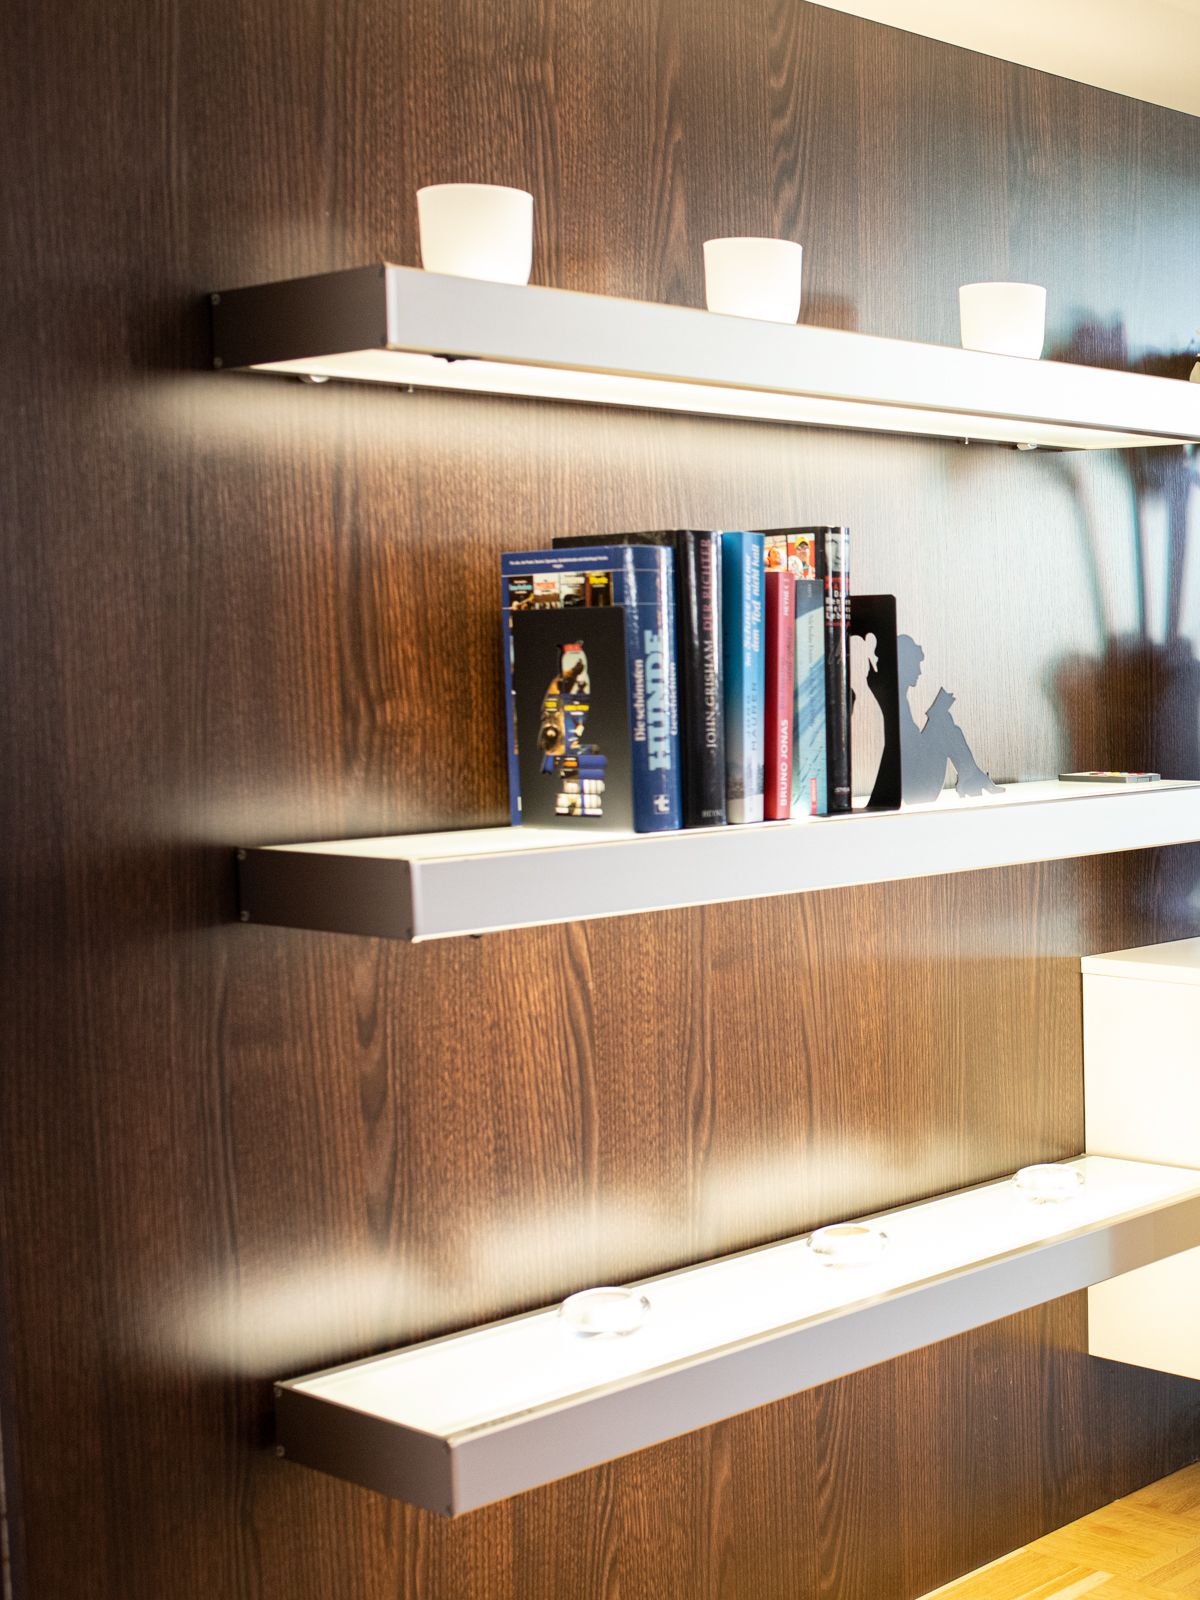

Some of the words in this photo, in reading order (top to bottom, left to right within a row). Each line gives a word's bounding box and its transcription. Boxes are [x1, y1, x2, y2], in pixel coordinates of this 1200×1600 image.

[700, 539, 713, 599] RICHTER
[703, 605, 712, 631] DER
[751, 601, 761, 625] Tod
[634, 659, 645, 720] schönsten
[703, 640, 717, 707] GRISHAM
[644, 630, 671, 772] HUNDE
[634, 722, 646, 742] Die
[704, 711, 718, 749] JOHN
[780, 720, 789, 759] JONAS
